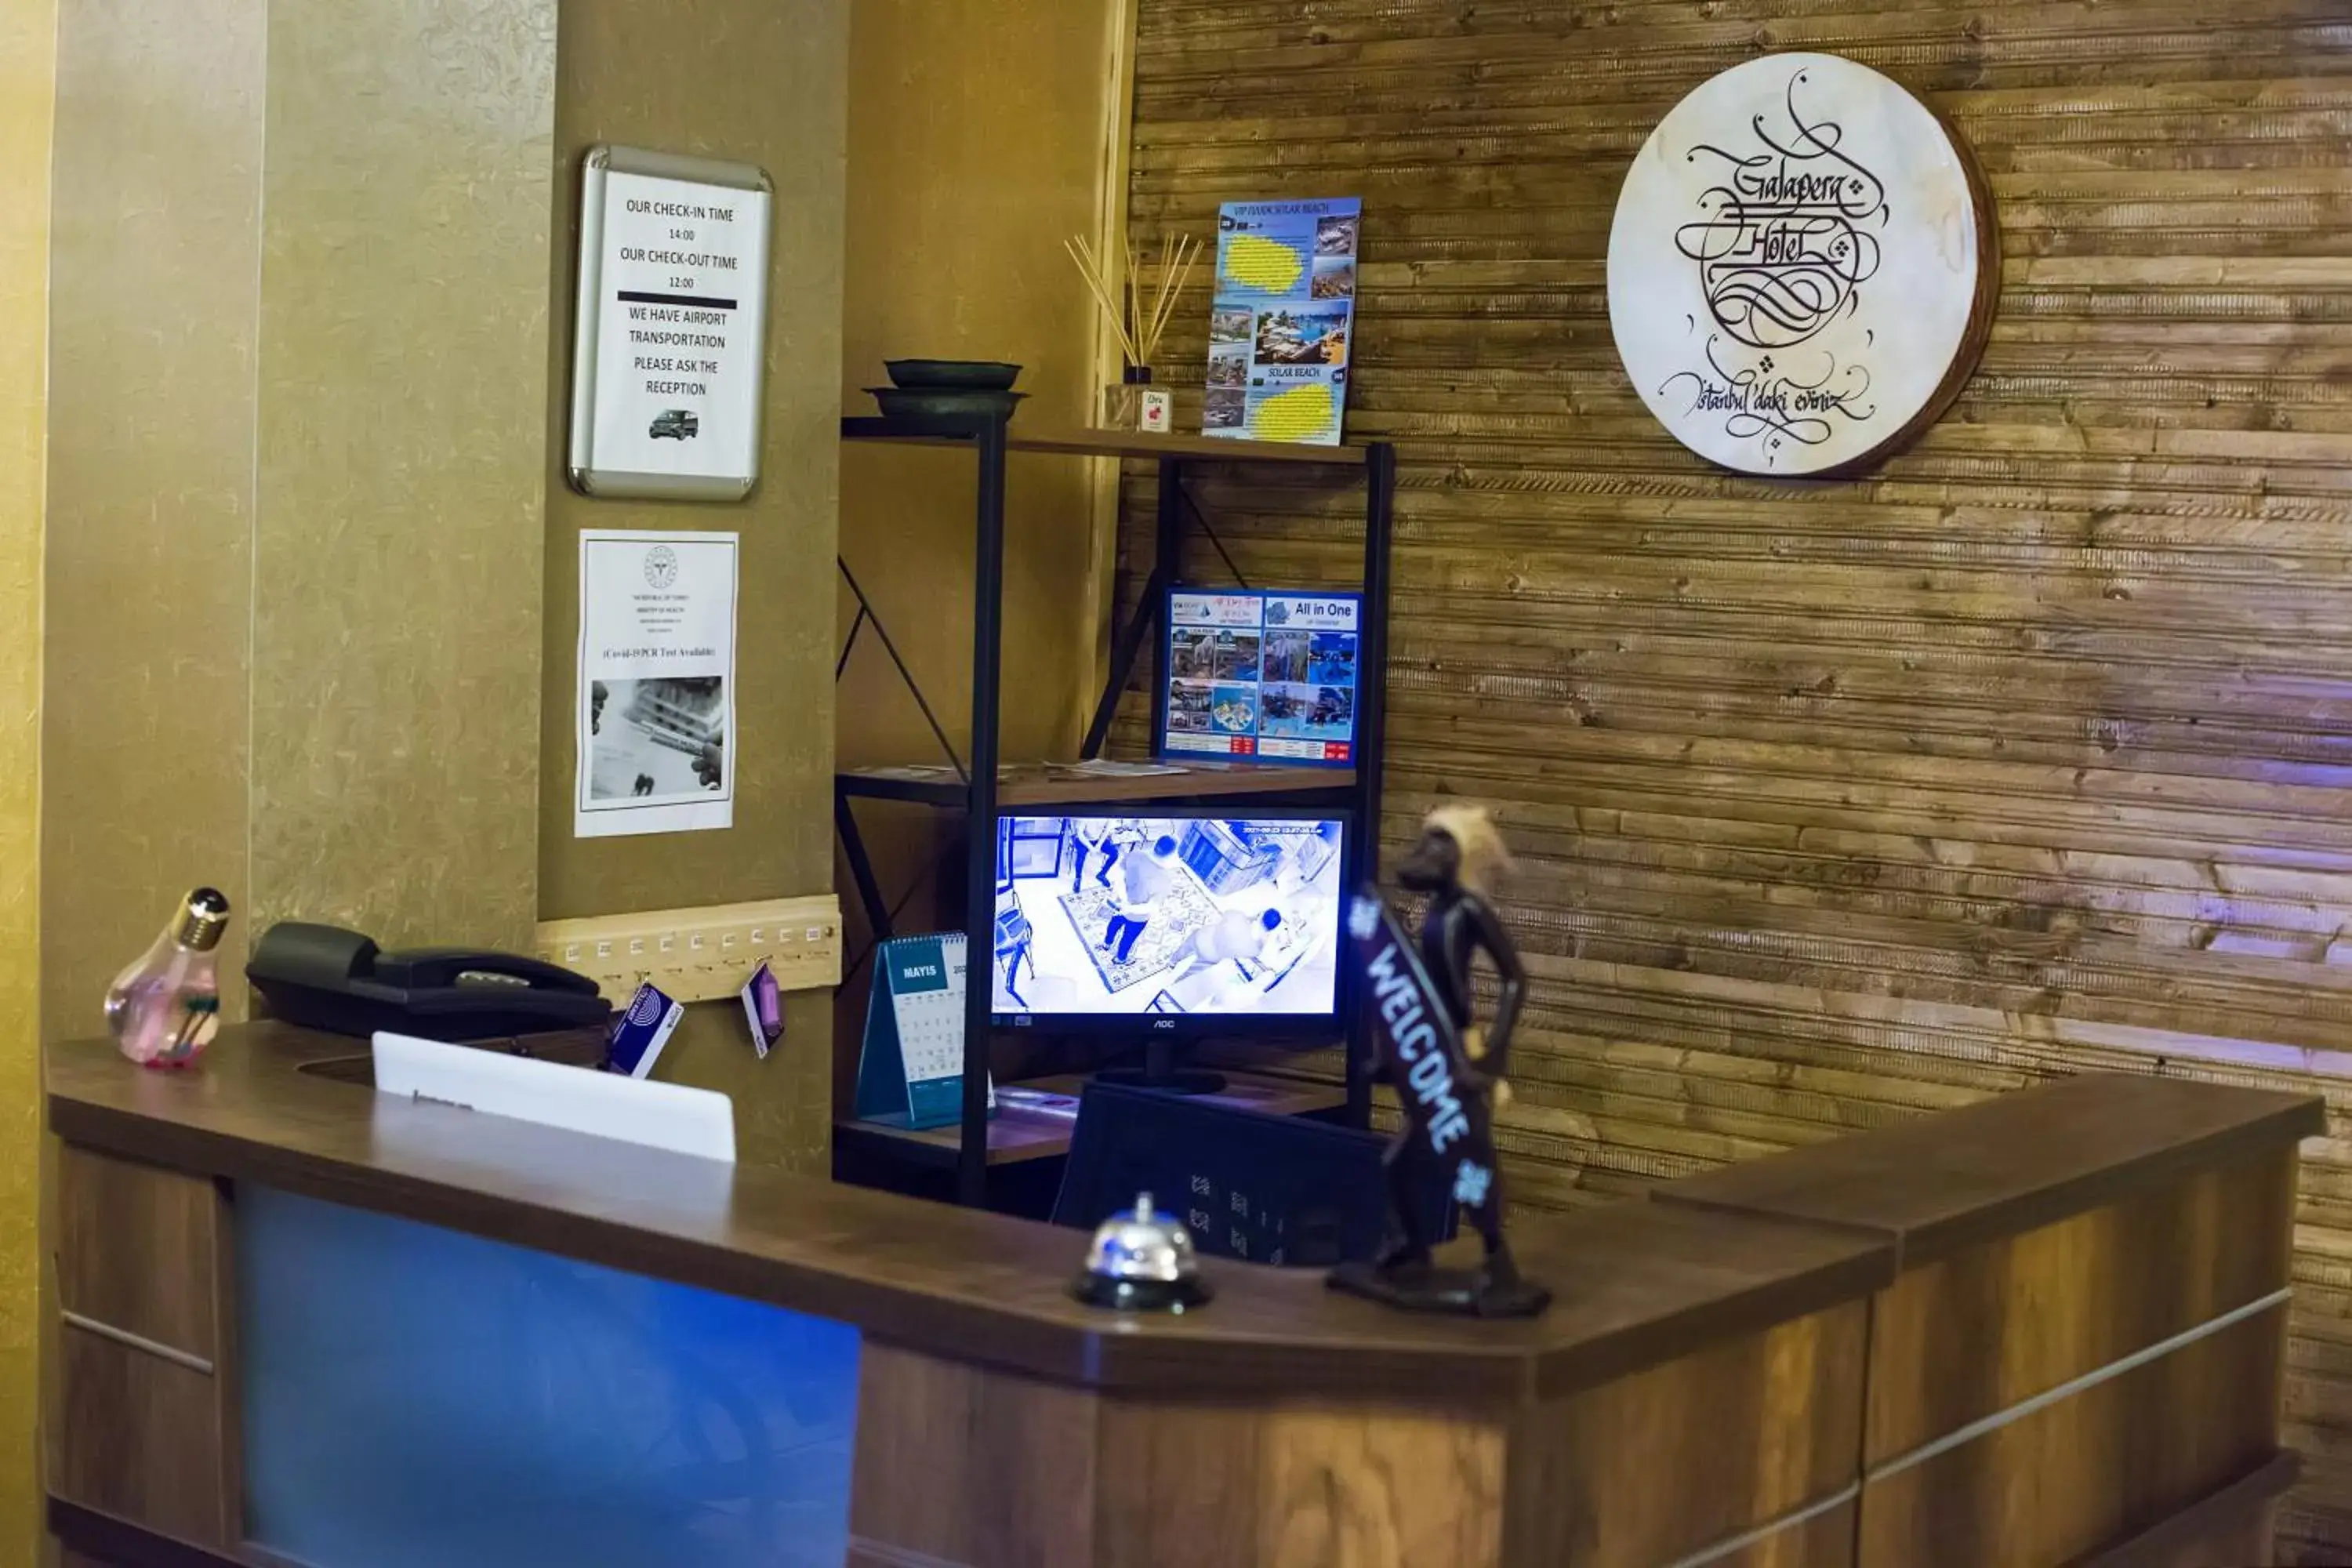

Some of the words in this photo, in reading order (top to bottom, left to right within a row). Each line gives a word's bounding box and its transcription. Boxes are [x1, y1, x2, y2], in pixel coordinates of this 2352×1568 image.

[626, 199, 652, 214] OUR
[653, 202, 706, 220] CHECK-IN
[709, 208, 734, 222] TIME
[669, 228, 695, 241] 14:00
[1732, 220, 1805, 264] Hotel
[620, 247, 645, 262] OUR
[648, 250, 710, 268] CHECK-OUT
[712, 256, 738, 270] TIME
[669, 277, 694, 289] 12:00
[629, 307, 647, 321] WE
[650, 308, 681, 322] HAVE
[683, 311, 727, 325] AIRPORT
[629, 330, 726, 348] TRANSPORTATION
[634, 357, 673, 371] PLEASE
[676, 359, 698, 372] ASK
[700, 361, 719, 374] THE
[645, 380, 706, 395] RECEPTION
[1295, 601, 1311, 615] All
[1313, 602, 1324, 615] in
[1327, 603, 1352, 617] One
[953, 965, 966, 975] 202
[1154, 1020, 1174, 1029] AOC
[1367, 942, 1471, 1156] WELCOME
